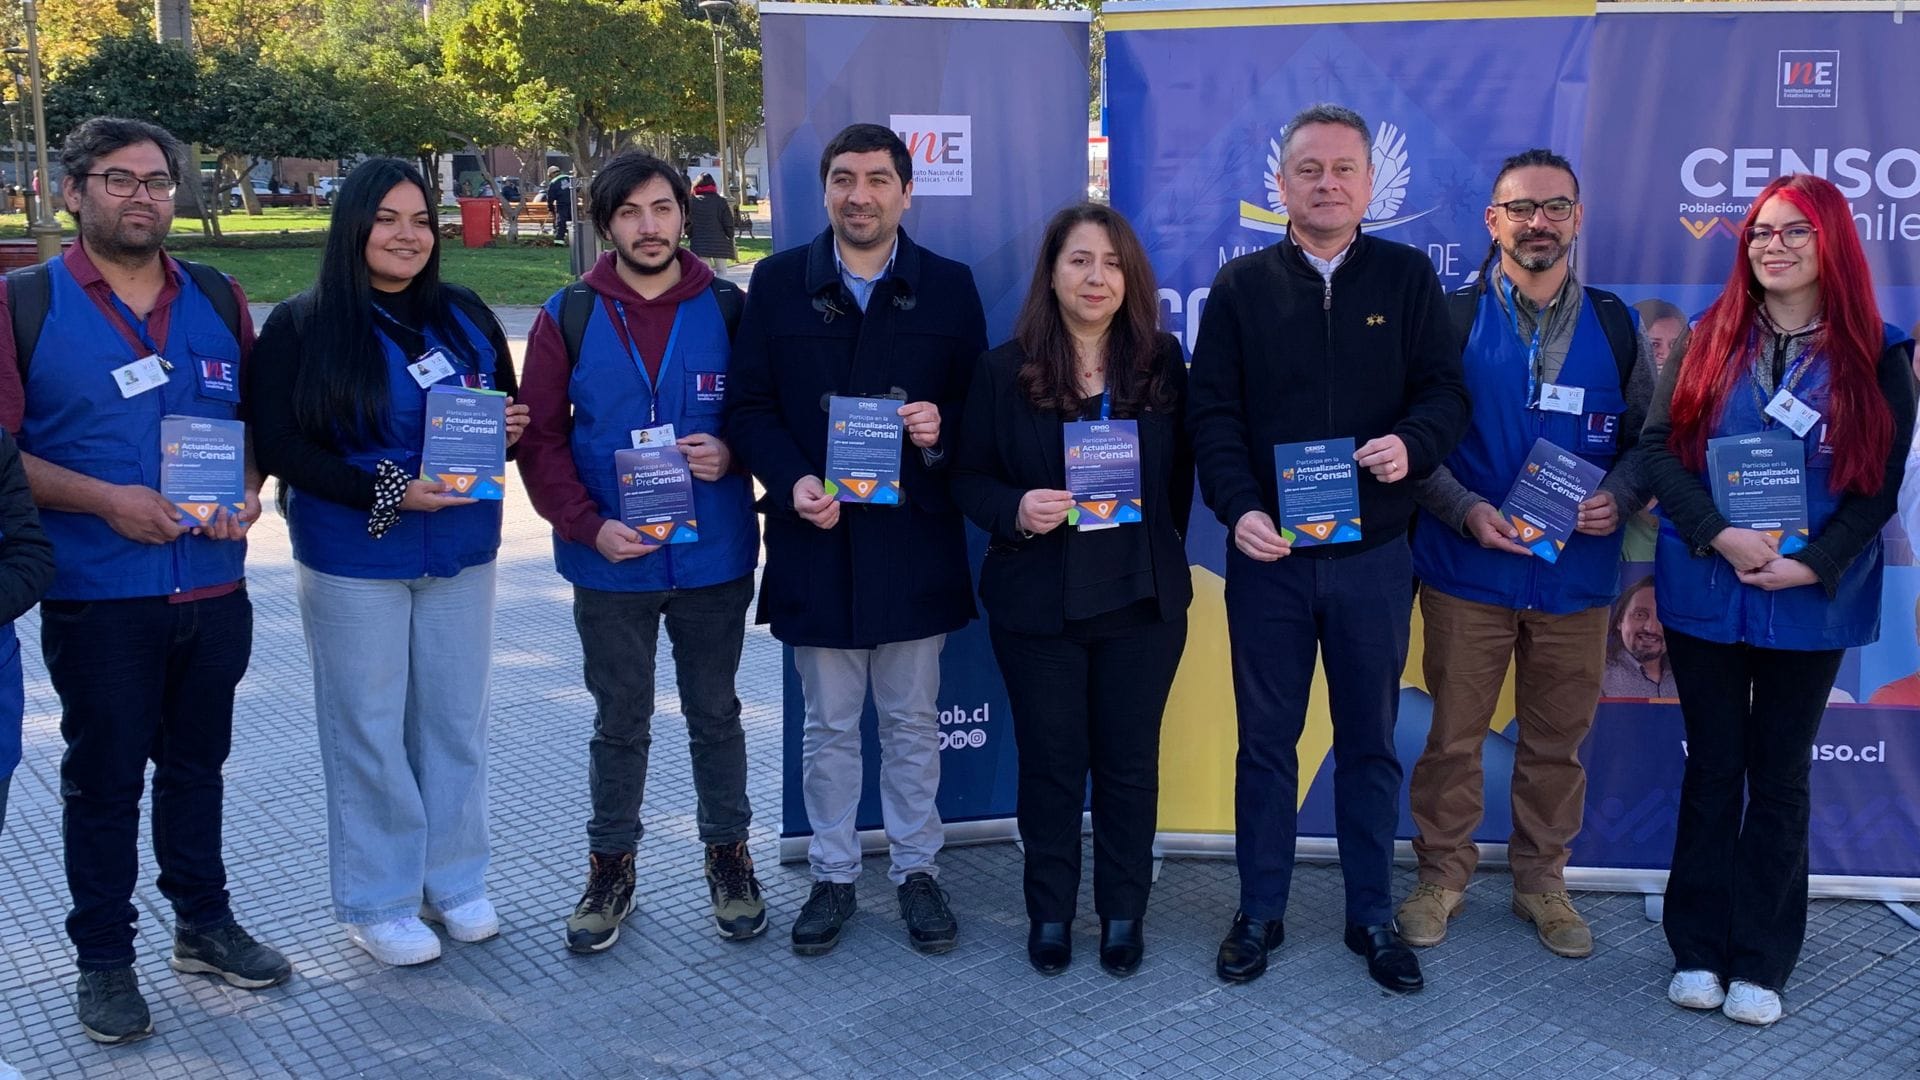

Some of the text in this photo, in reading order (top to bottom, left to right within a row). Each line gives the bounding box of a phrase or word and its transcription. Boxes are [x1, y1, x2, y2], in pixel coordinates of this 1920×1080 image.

[1428, 243, 1461, 276] DE
[445, 417, 498, 426] Actualización
[849, 414, 874, 422] Participa
[446, 424, 497, 435] PreCensal
[848, 421, 899, 430] Actualización
[848, 428, 897, 439] PreCensal
[181, 443, 235, 451] Actualización
[1082, 443, 1133, 452] Actualización
[182, 451, 235, 460] PreCensal
[1083, 450, 1133, 460] PreCensal
[634, 467, 684, 479] Actualización
[1296, 463, 1351, 474] Actualización
[1742, 468, 1800, 477] Actualización
[636, 474, 685, 487] PreCensal
[1297, 470, 1352, 482] PreCensal
[1540, 467, 1587, 495] Actualización
[1743, 476, 1800, 487] PreCensal
[1537, 474, 1585, 503] PreCensal
